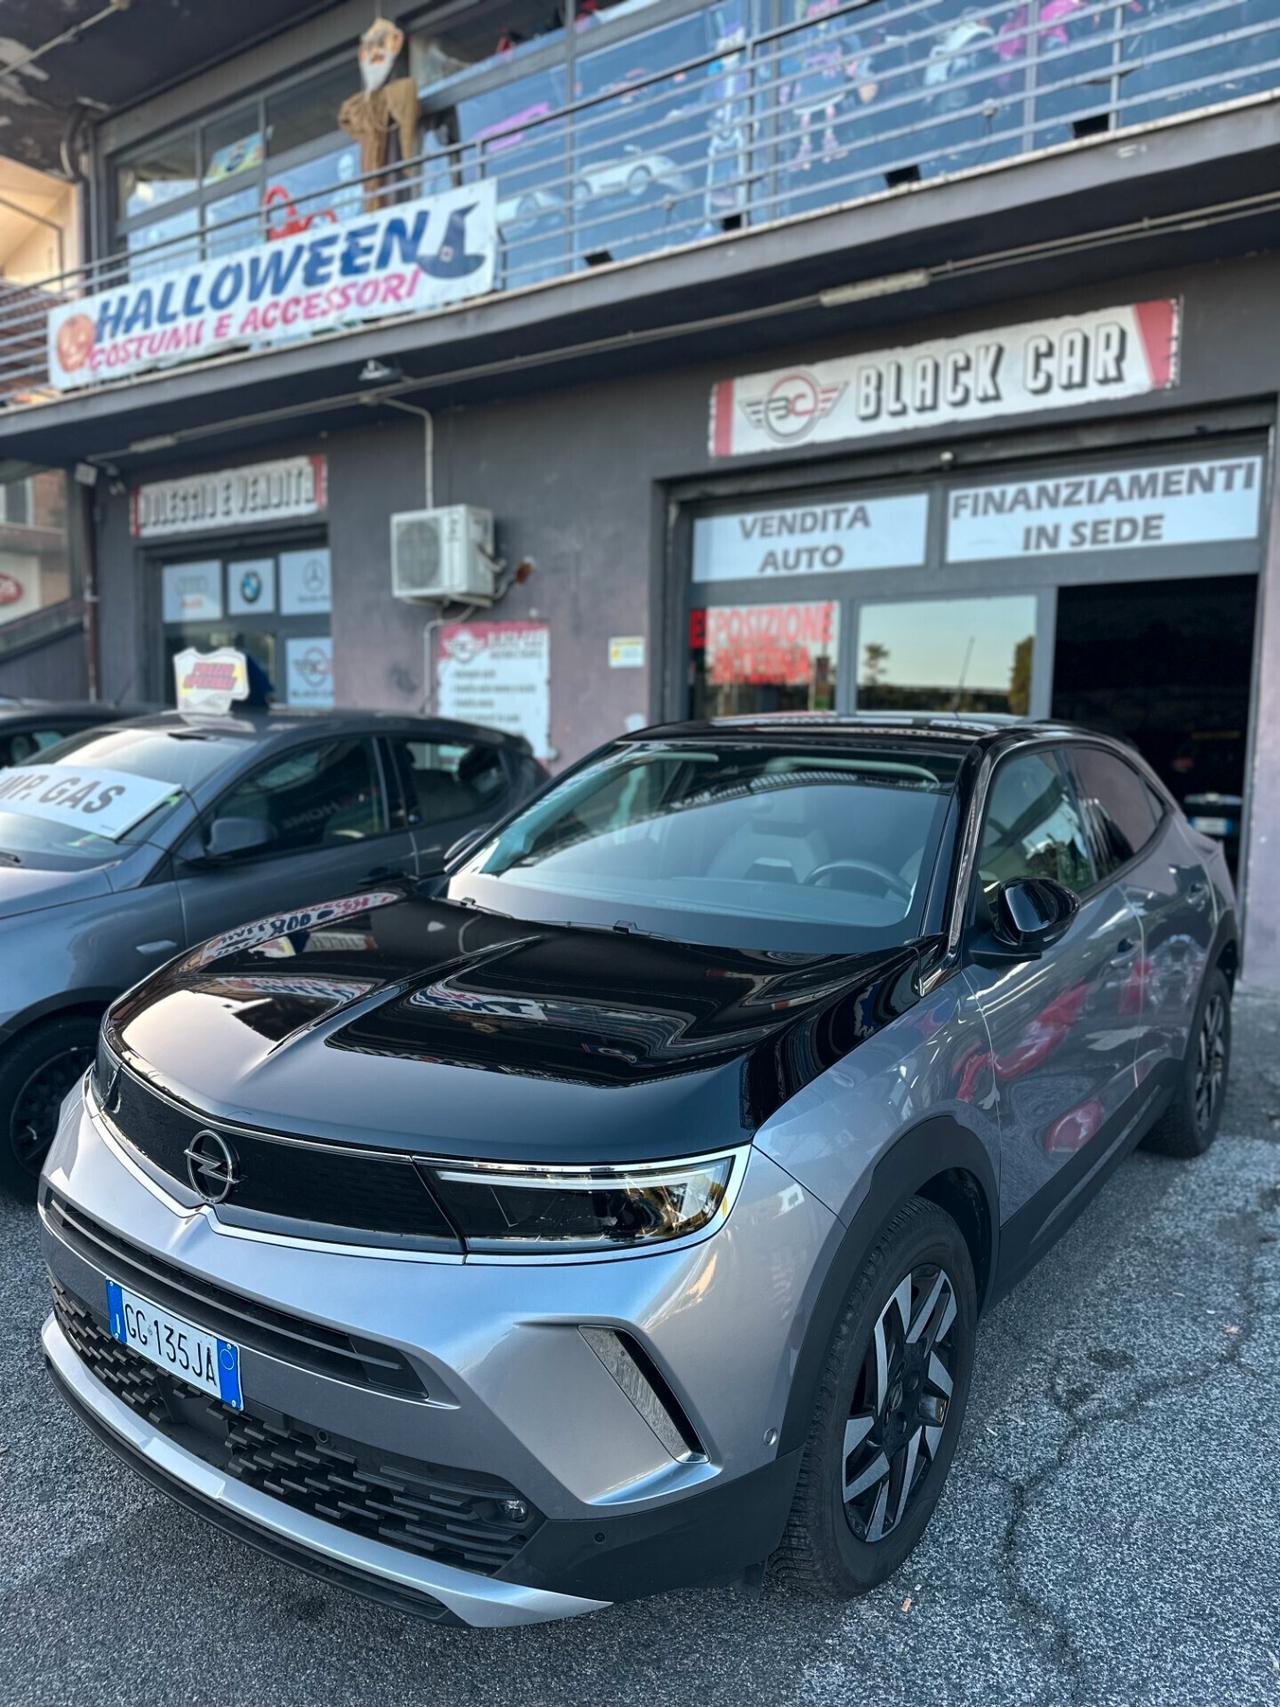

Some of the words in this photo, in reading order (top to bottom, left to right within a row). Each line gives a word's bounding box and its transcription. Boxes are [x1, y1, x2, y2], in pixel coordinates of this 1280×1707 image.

[94, 210, 429, 342] HALLOWEEN
[88, 321, 203, 371] COSTUMI
[213, 317, 229, 339] E
[239, 269, 421, 334] ACCESSORI
[856, 342, 1005, 421] BLACK
[1024, 321, 1127, 395] CAR
[952, 460, 1257, 519] FINANZIAMENTI
[739, 504, 871, 540] VENDITA
[1023, 523, 1061, 552] IN
[1069, 514, 1165, 547] SEDE
[758, 543, 844, 574] AUTO
[38, 776, 126, 814] GAS
